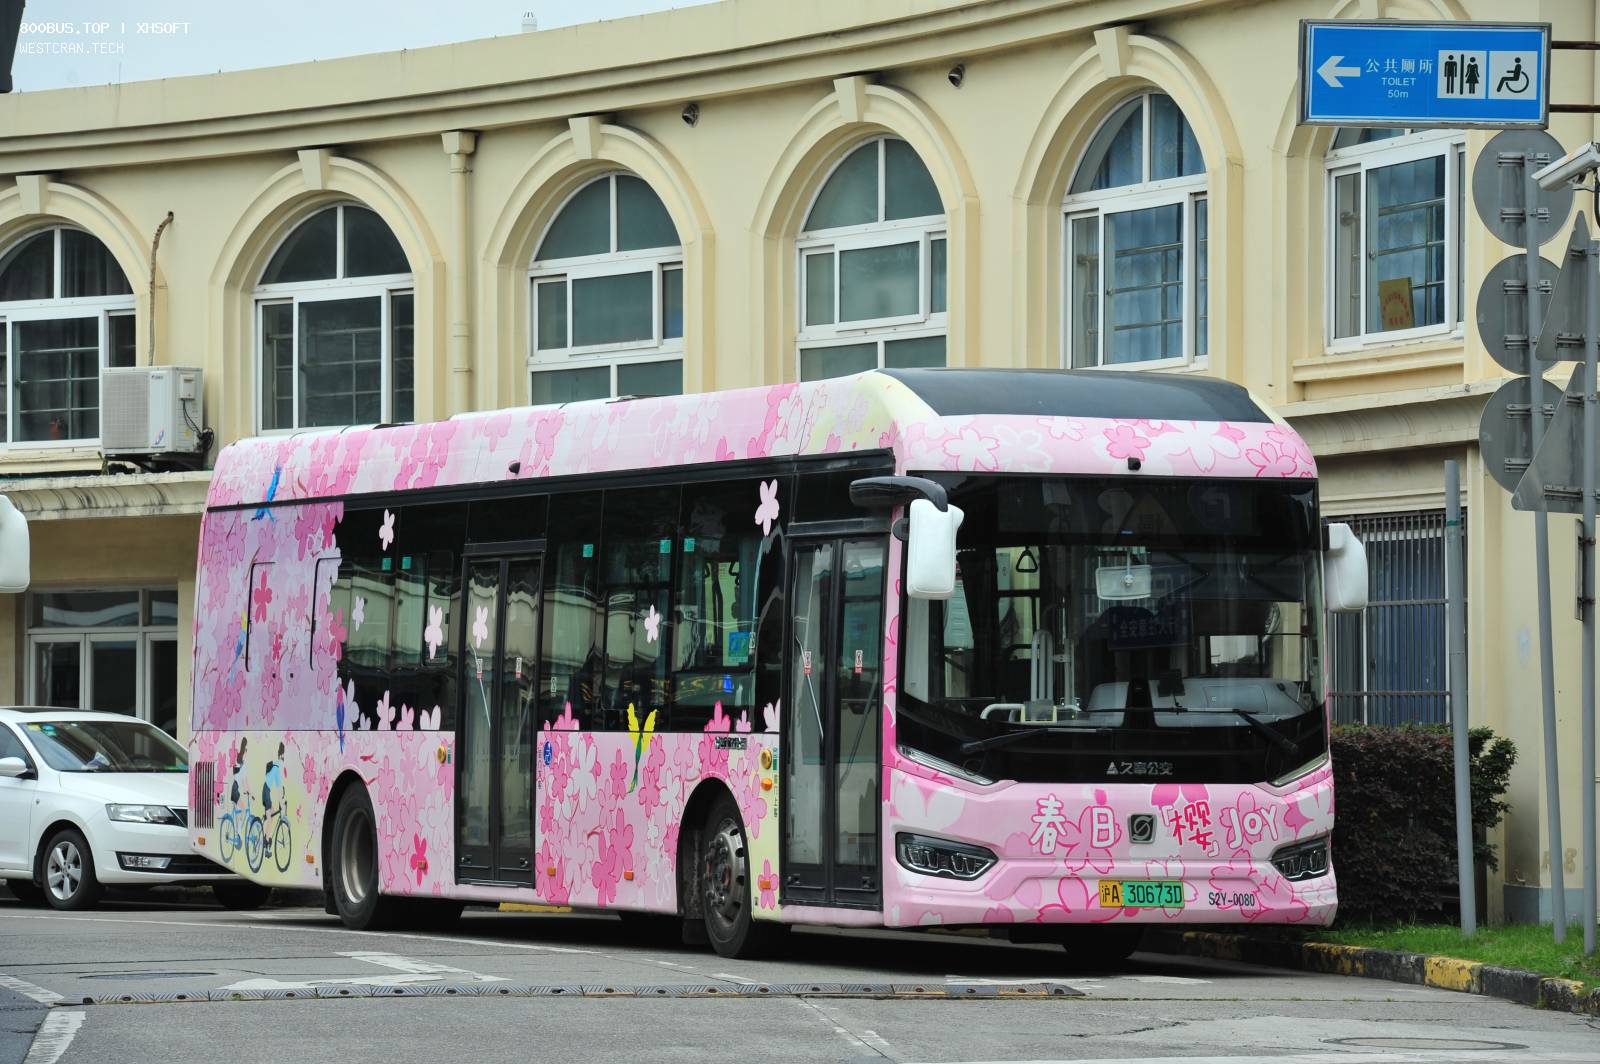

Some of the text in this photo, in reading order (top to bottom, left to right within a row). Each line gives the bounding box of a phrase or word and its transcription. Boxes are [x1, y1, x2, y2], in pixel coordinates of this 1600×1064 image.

[1365, 57, 1434, 75] 公共厕所
[1381, 77, 1417, 86] TOILET
[1387, 89, 1409, 98] 50m
[1119, 761, 1174, 776] 久事公交
[1227, 804, 1279, 849] JOY
